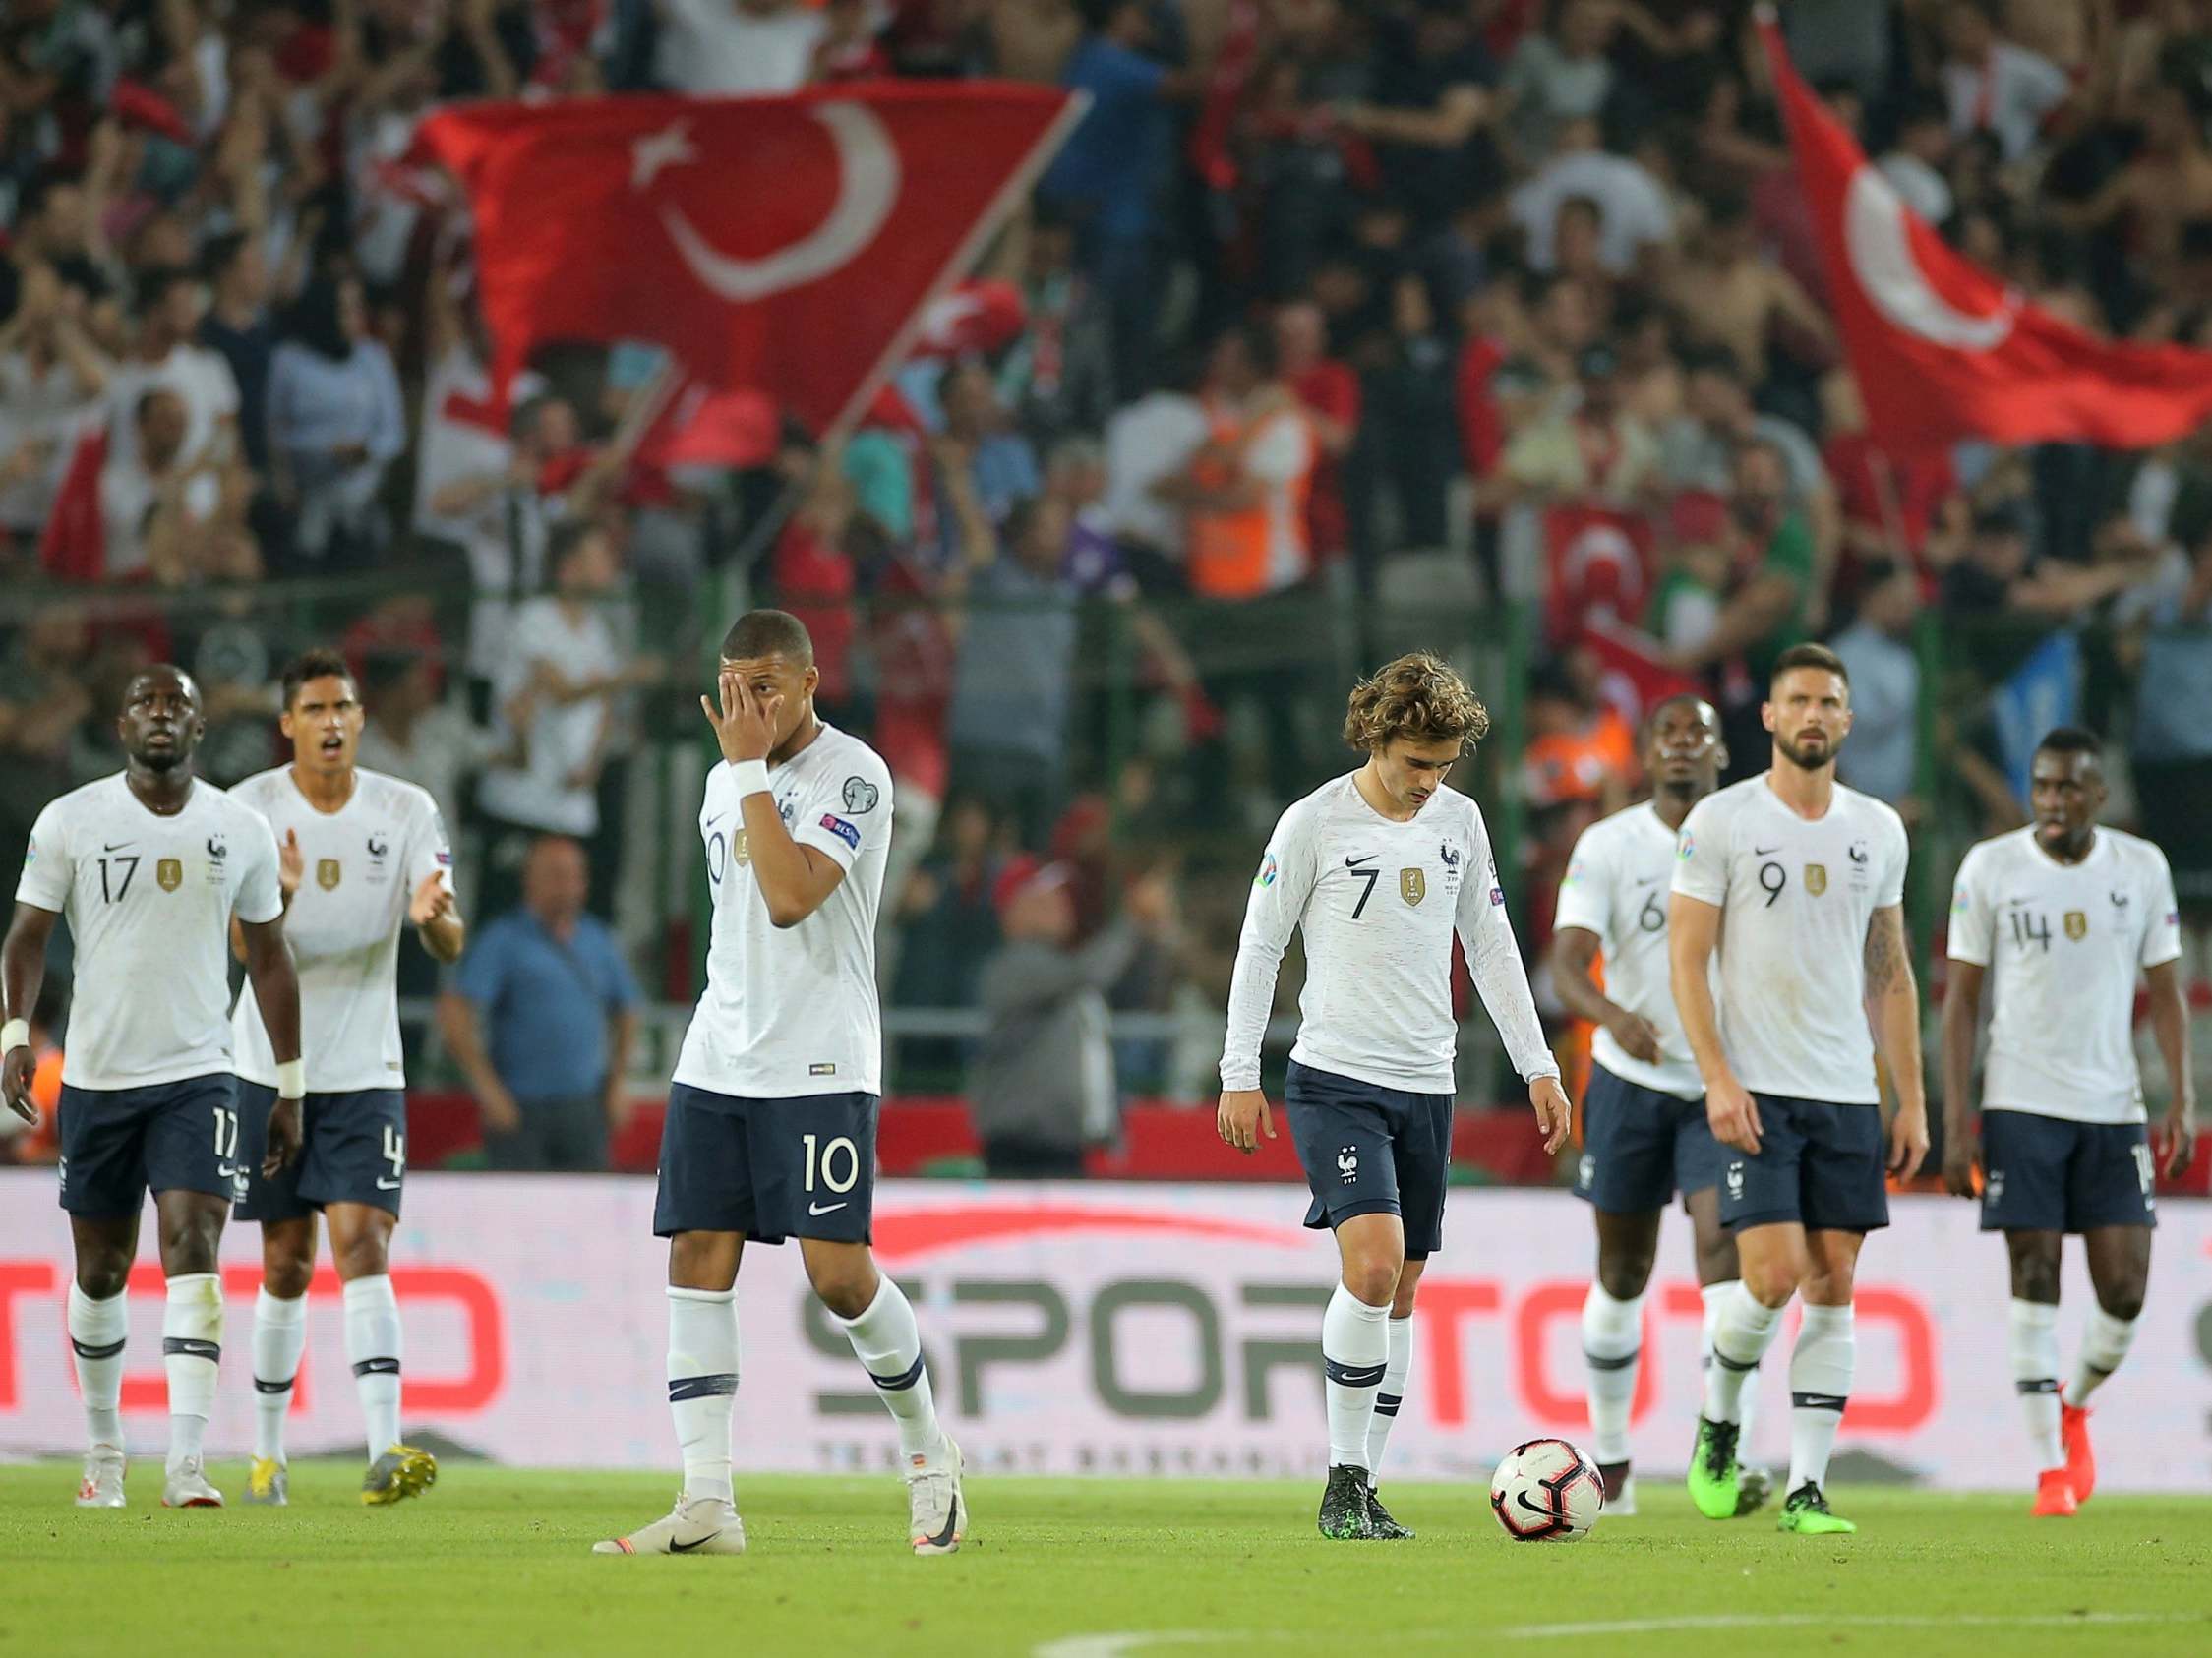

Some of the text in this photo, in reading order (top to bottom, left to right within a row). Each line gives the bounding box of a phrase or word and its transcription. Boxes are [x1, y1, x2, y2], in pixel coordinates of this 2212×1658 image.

[97, 856, 141, 904] 17
[1351, 869, 1380, 919] 7
[1760, 861, 1786, 907] 9
[1640, 891, 1665, 932] 6
[2010, 912, 2052, 953] 14
[213, 1107, 238, 1159] 17
[383, 1125, 405, 1178] 4
[803, 1134, 859, 1193] 10
